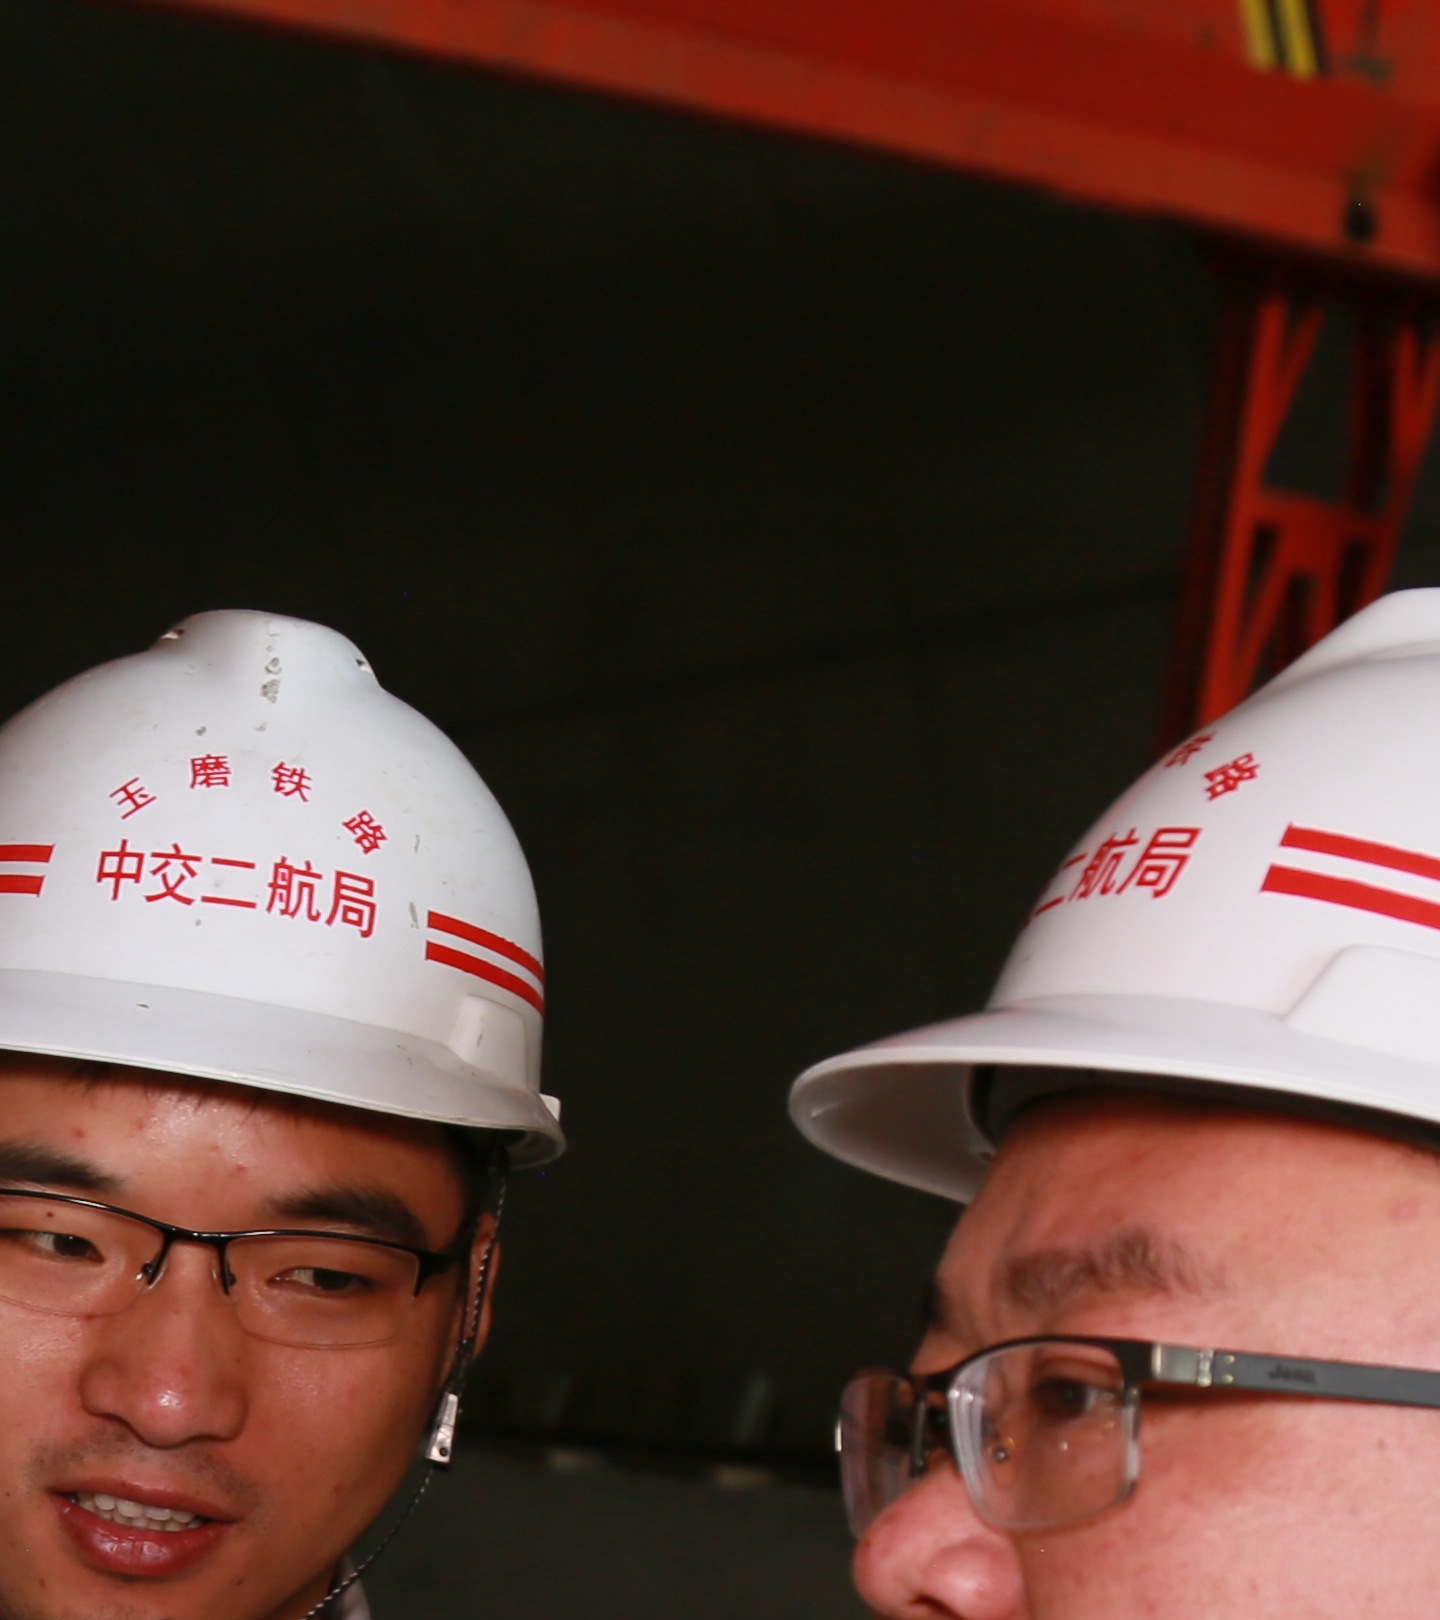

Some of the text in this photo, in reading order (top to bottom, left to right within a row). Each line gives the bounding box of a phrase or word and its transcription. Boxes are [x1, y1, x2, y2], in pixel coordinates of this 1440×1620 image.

[109, 753, 390, 856] 玉磨铁路
[95, 838, 379, 940] 中交二航局
[1023, 826, 1203, 922] 二航局
